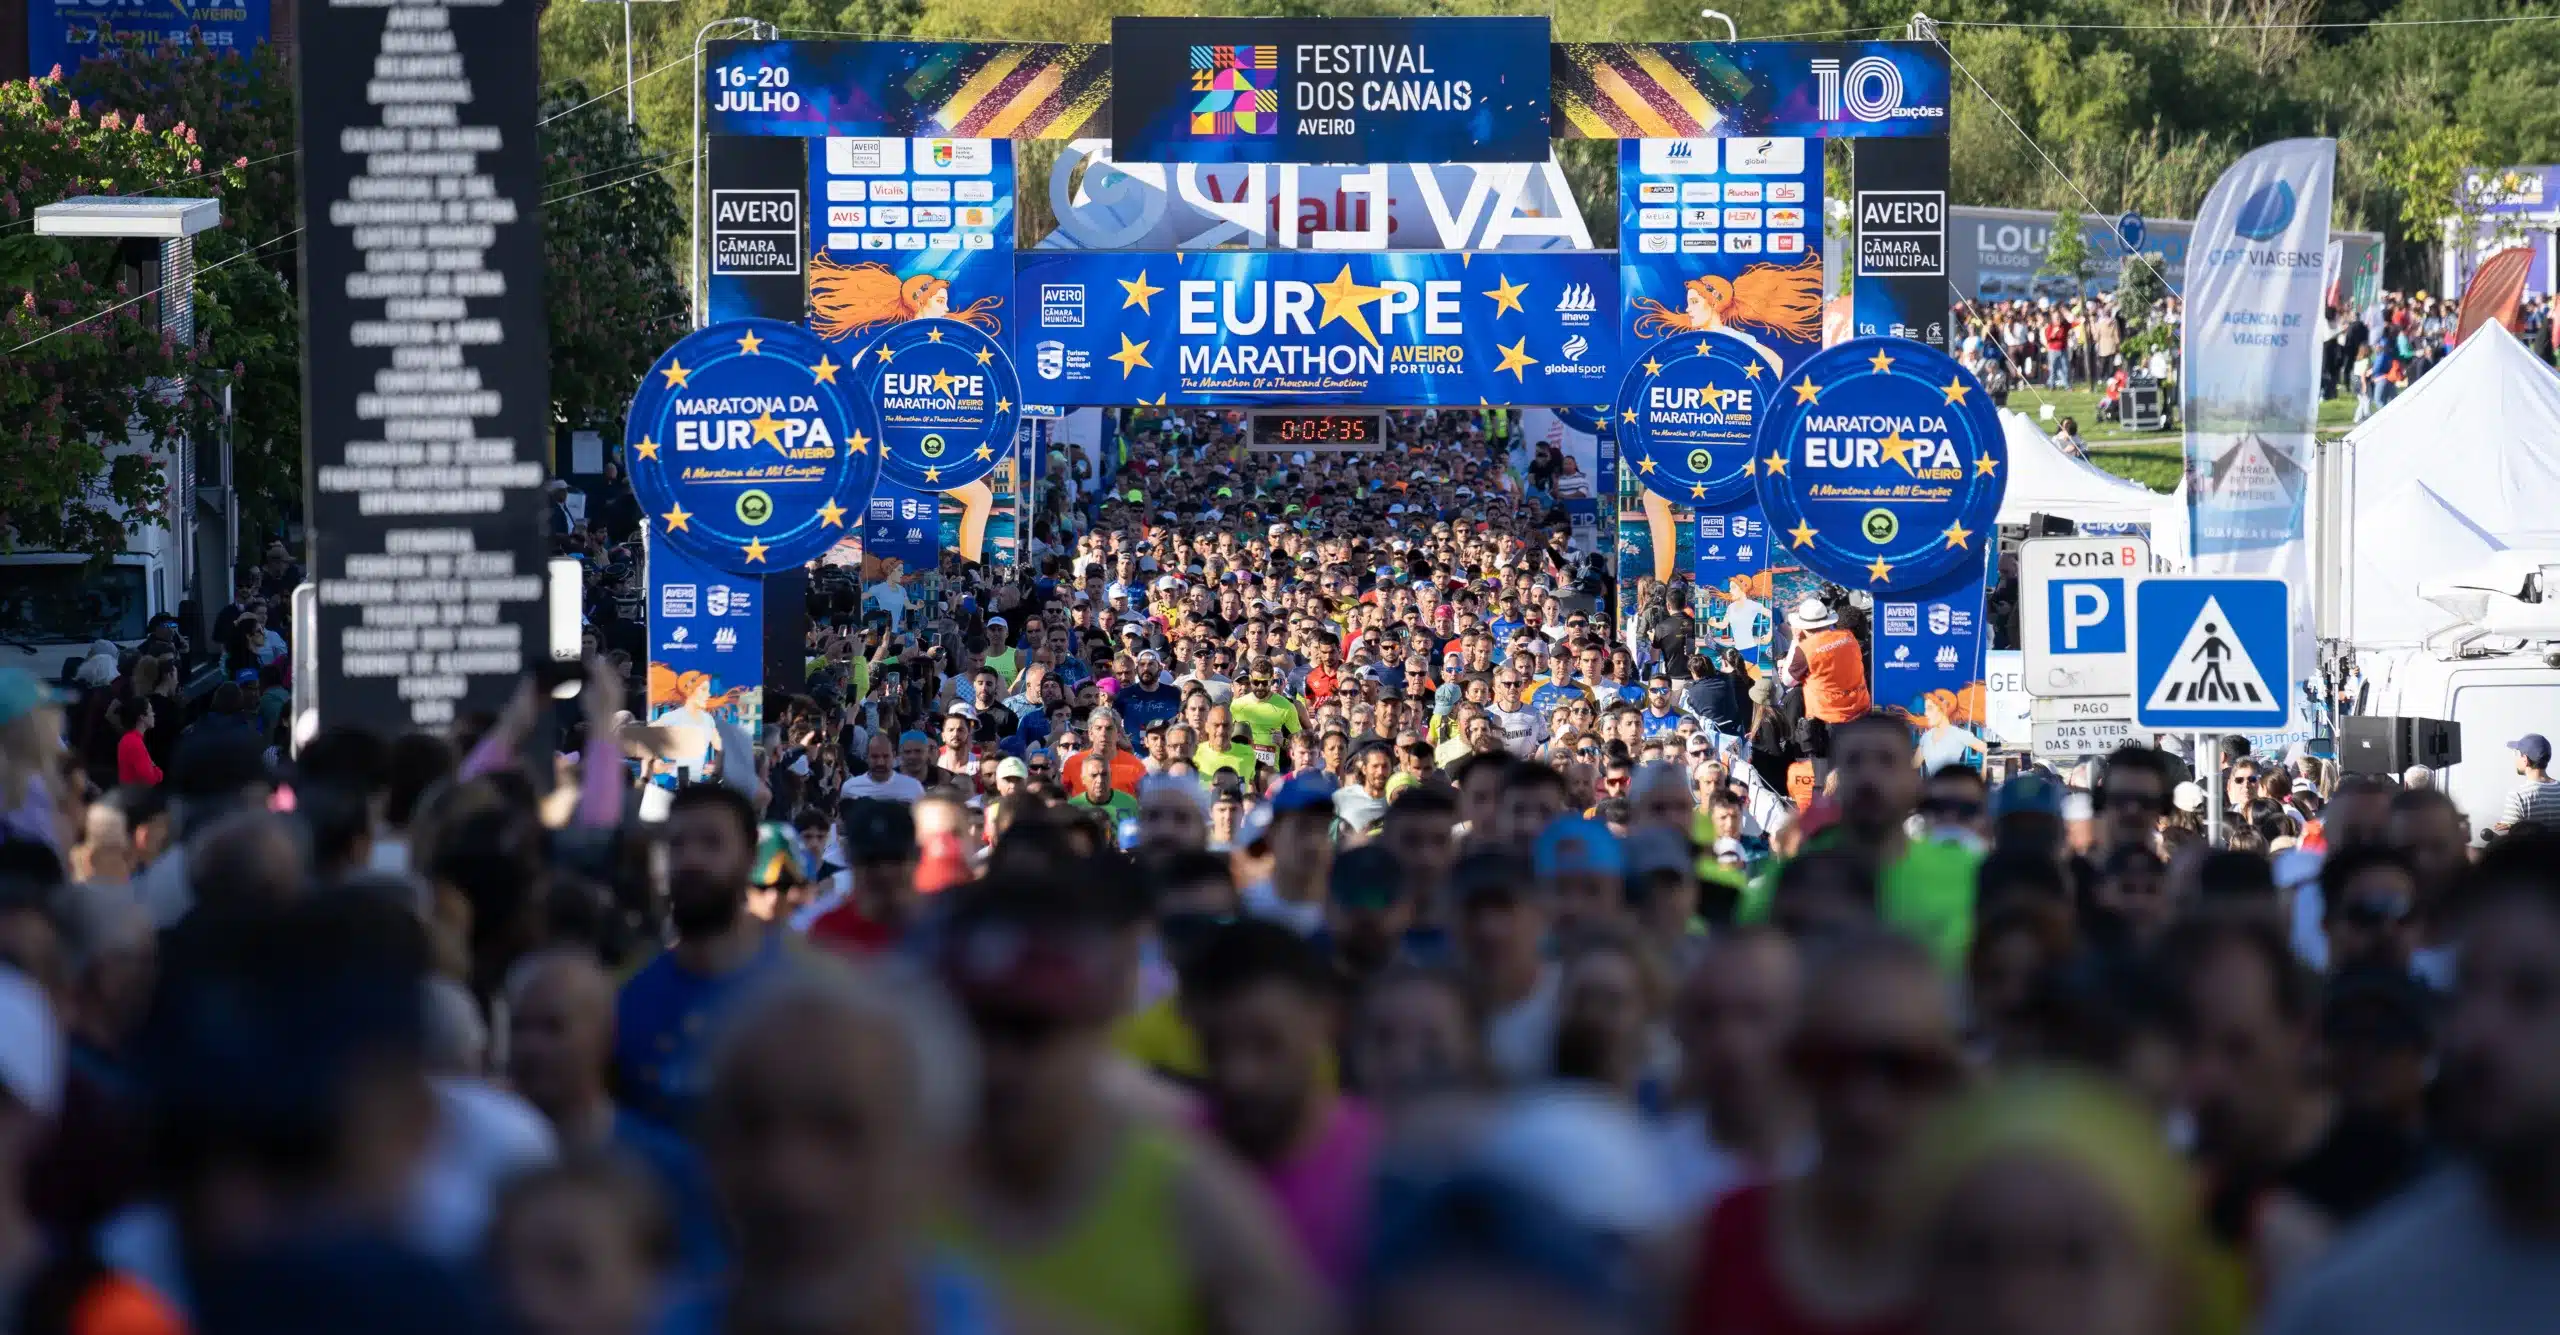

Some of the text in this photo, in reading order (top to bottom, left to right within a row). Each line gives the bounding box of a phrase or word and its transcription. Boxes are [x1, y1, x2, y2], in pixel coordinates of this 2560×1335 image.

[1296, 44, 1435, 74] FESTIVAL
[715, 66, 789, 88] 16-20
[1297, 80, 1472, 112] DOS CANAIS
[1811, 56, 1904, 122] 10
[714, 91, 800, 112] JULHO
[1891, 106, 1944, 119] EDIÇÕES
[1297, 118, 1355, 135] AVEIRO
[854, 143, 879, 151] AVEIRO
[874, 185, 904, 196] Vitalis
[1727, 188, 1759, 197] Auchan
[719, 201, 793, 223] AVEIRO
[833, 212, 860, 222] AVIS
[1864, 202, 1939, 224] AVEIRO
[1733, 235, 1752, 249] tvi
[719, 253, 793, 266] MUNICIPAL
[1864, 255, 1938, 267] MUNICIPAL
[1045, 290, 1082, 302] AVEIRO
[2282, 313, 2302, 328] DE
[2232, 331, 2289, 347] VIAGENS
[1179, 344, 1384, 375] MARATHON
[1390, 345, 1464, 362] AVEIRO
[1066, 361, 1091, 369] Portugal
[1390, 364, 1464, 375] PORTUGAL
[1180, 377, 1198, 389] The
[1199, 377, 1250, 389] Marathon
[1274, 377, 1320, 389] Thousand
[1322, 377, 1369, 389] Emotions
[676, 396, 818, 415] MARATONA DA
[884, 397, 956, 410] MARATHON
[1650, 411, 1724, 425] MARATHON
[1805, 415, 1948, 433] MARATONA DA
[1281, 420, 1365, 440] 0:02:35
[789, 447, 835, 459] AVEIRO
[1917, 468, 1963, 480] AVEIRO
[1809, 484, 1819, 496] A
[1820, 485, 1871, 496] Maratona
[1891, 485, 1911, 496] Mil
[2055, 546, 2137, 567] zona B
[2062, 583, 2110, 649] P
[2073, 703, 2109, 713] PAGO
[2057, 727, 2087, 737] DIAS
[2045, 740, 2070, 750] DAS
[2077, 739, 2092, 749] 9h
[2119, 738, 2142, 749] 20h
